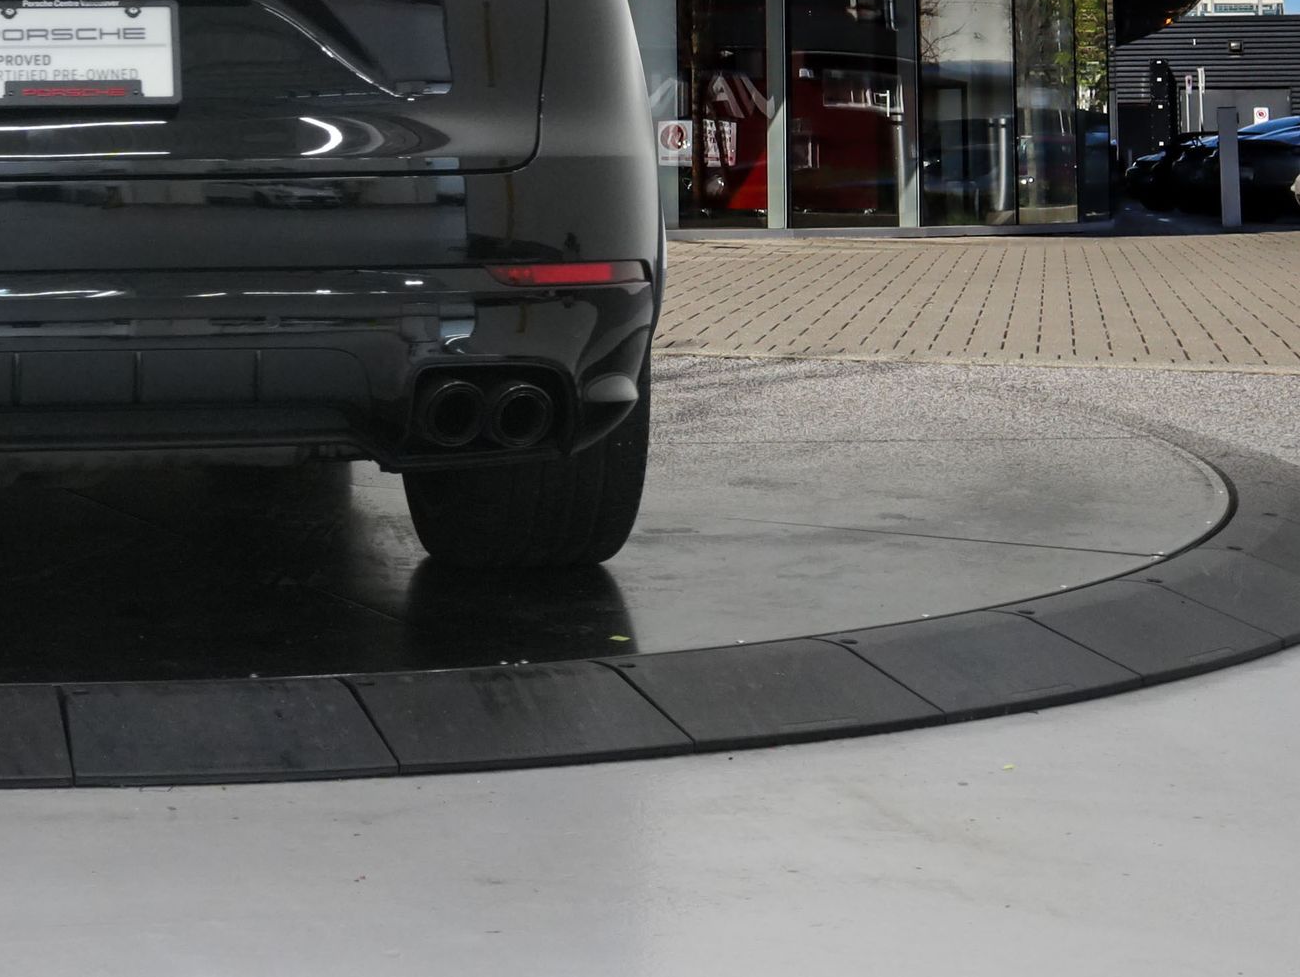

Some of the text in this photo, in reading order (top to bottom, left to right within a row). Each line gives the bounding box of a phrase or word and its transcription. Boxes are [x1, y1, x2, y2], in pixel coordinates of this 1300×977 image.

[22, 0, 51, 7] Porsche
[53, 0, 80, 7] Centre
[53, 68, 139, 81] PRE-OWNED
[21, 87, 127, 97] PORSCHE
